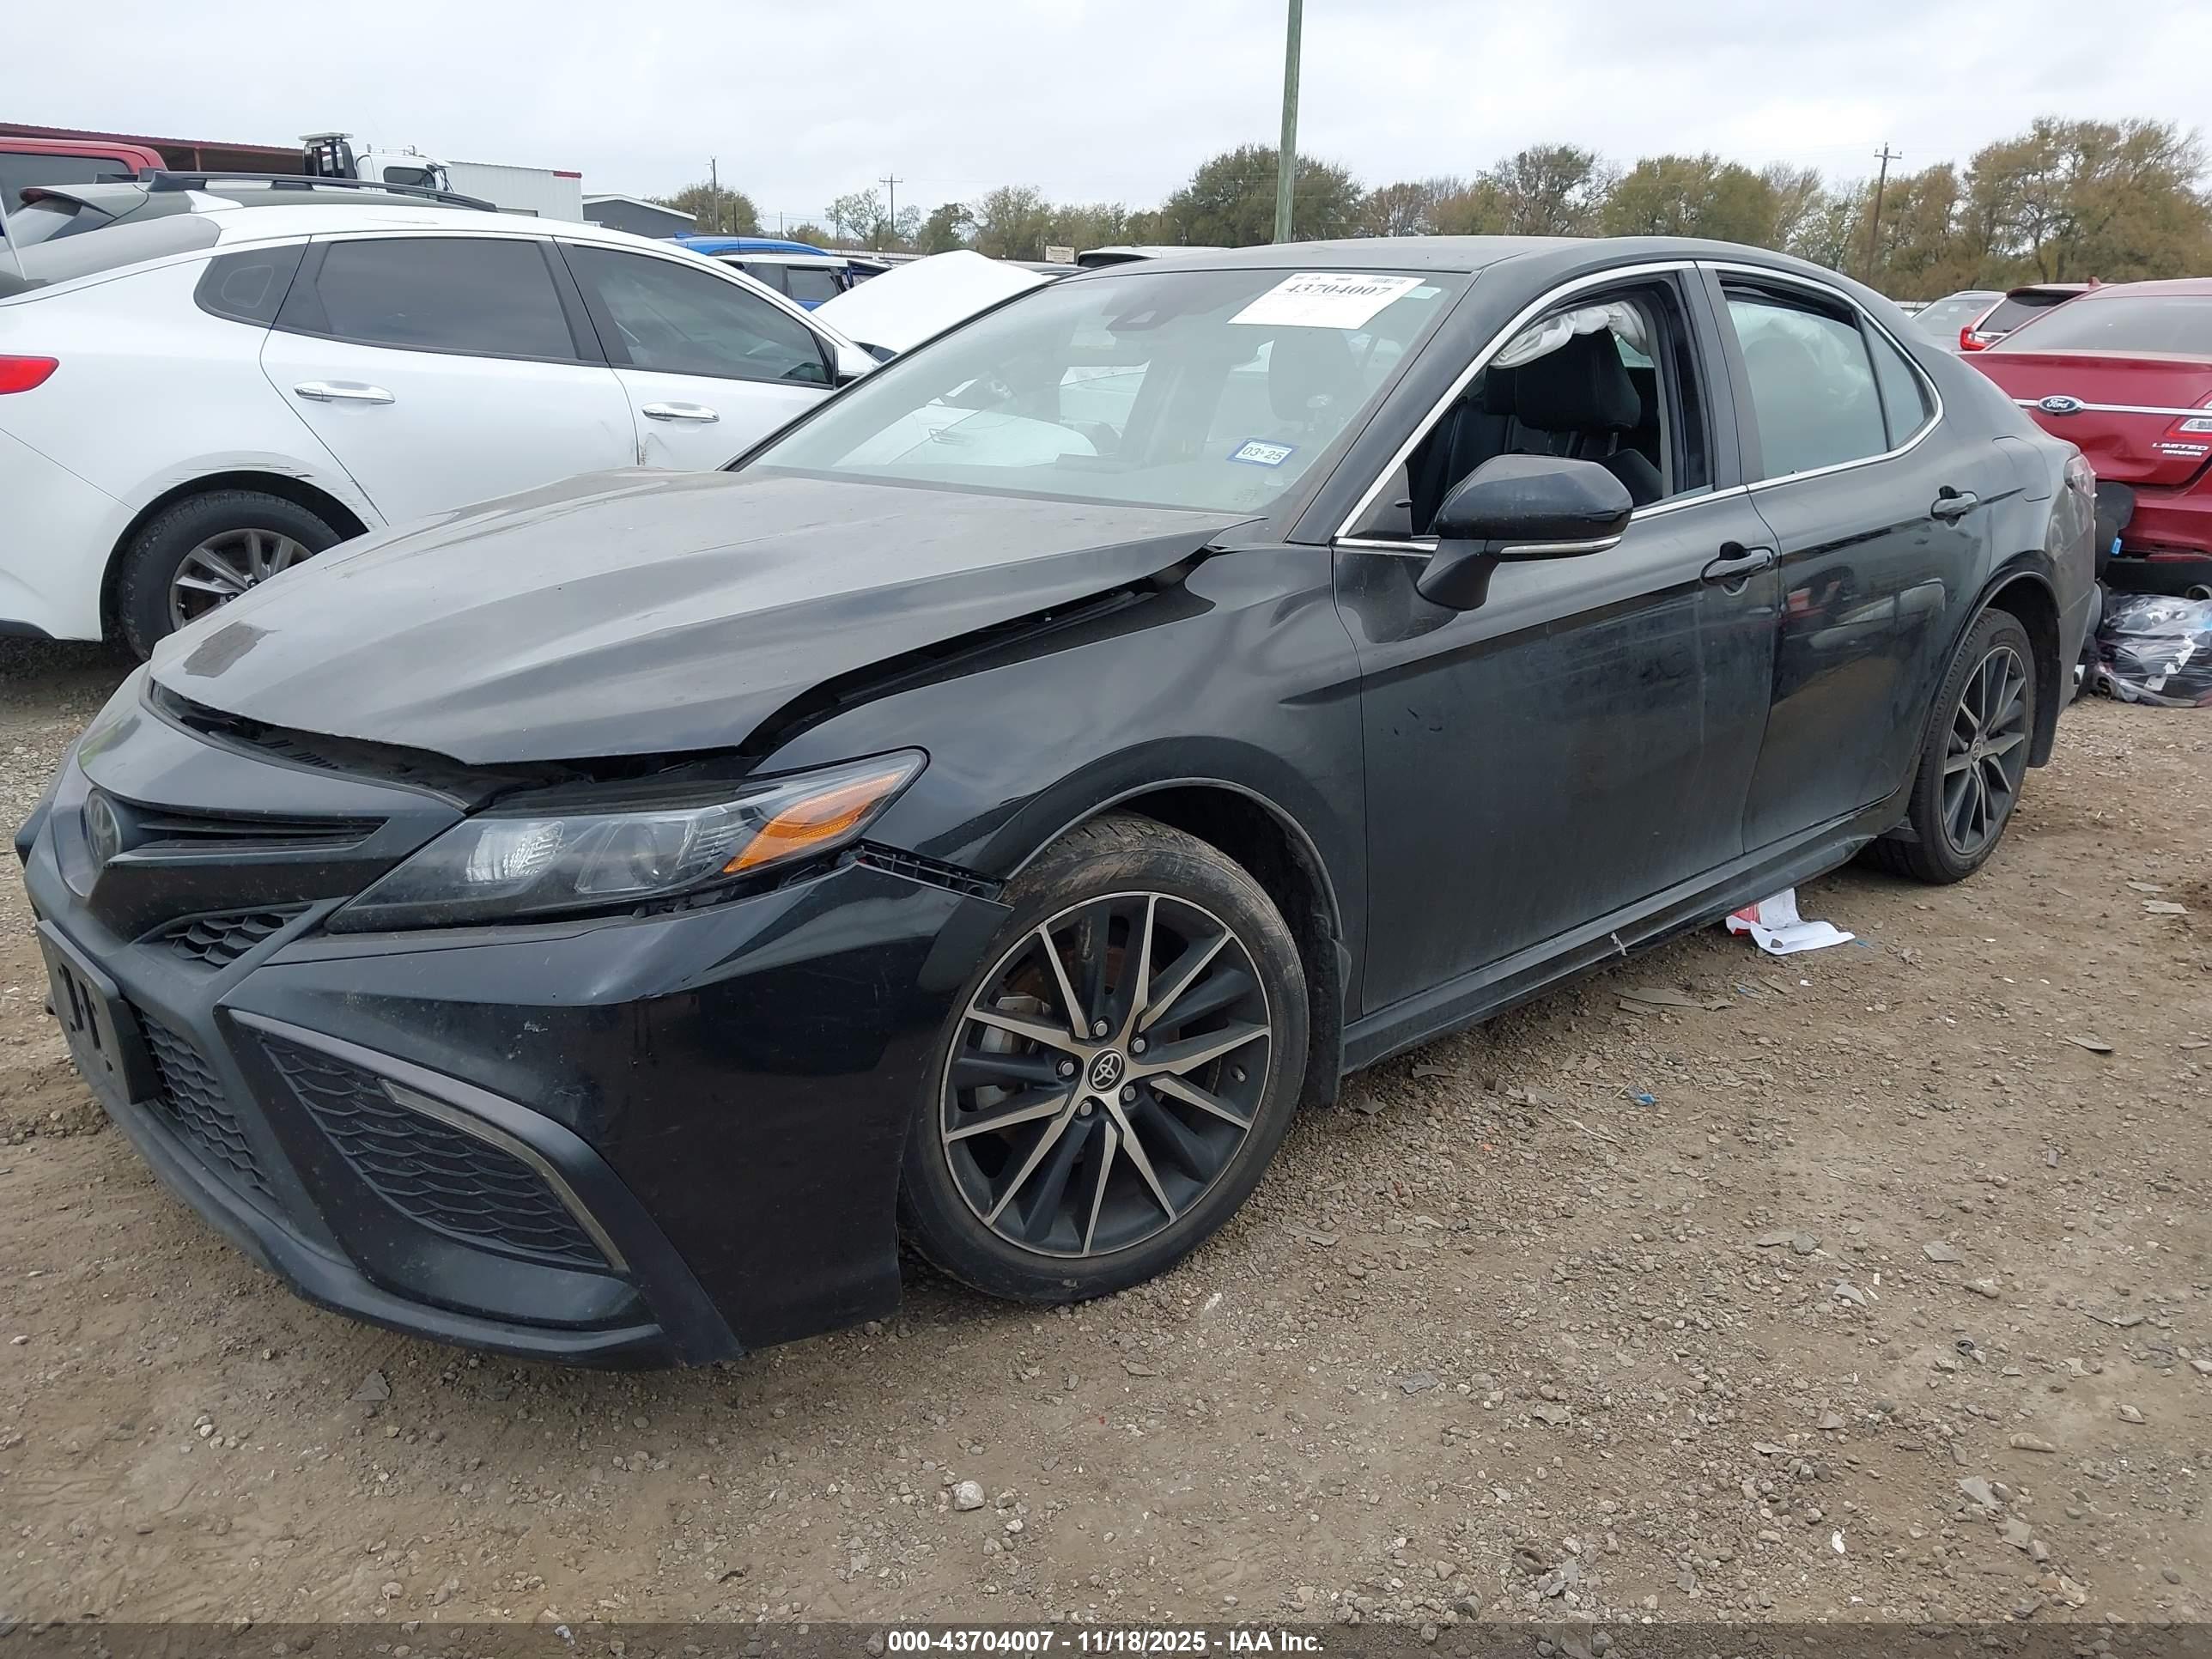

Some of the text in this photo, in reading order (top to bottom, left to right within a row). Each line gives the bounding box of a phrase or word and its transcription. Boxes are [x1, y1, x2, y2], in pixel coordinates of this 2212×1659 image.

[1285, 283, 1394, 296] 43704007
[2046, 398, 2069, 409] Ford
[2152, 442, 2209, 451] LIMITED
